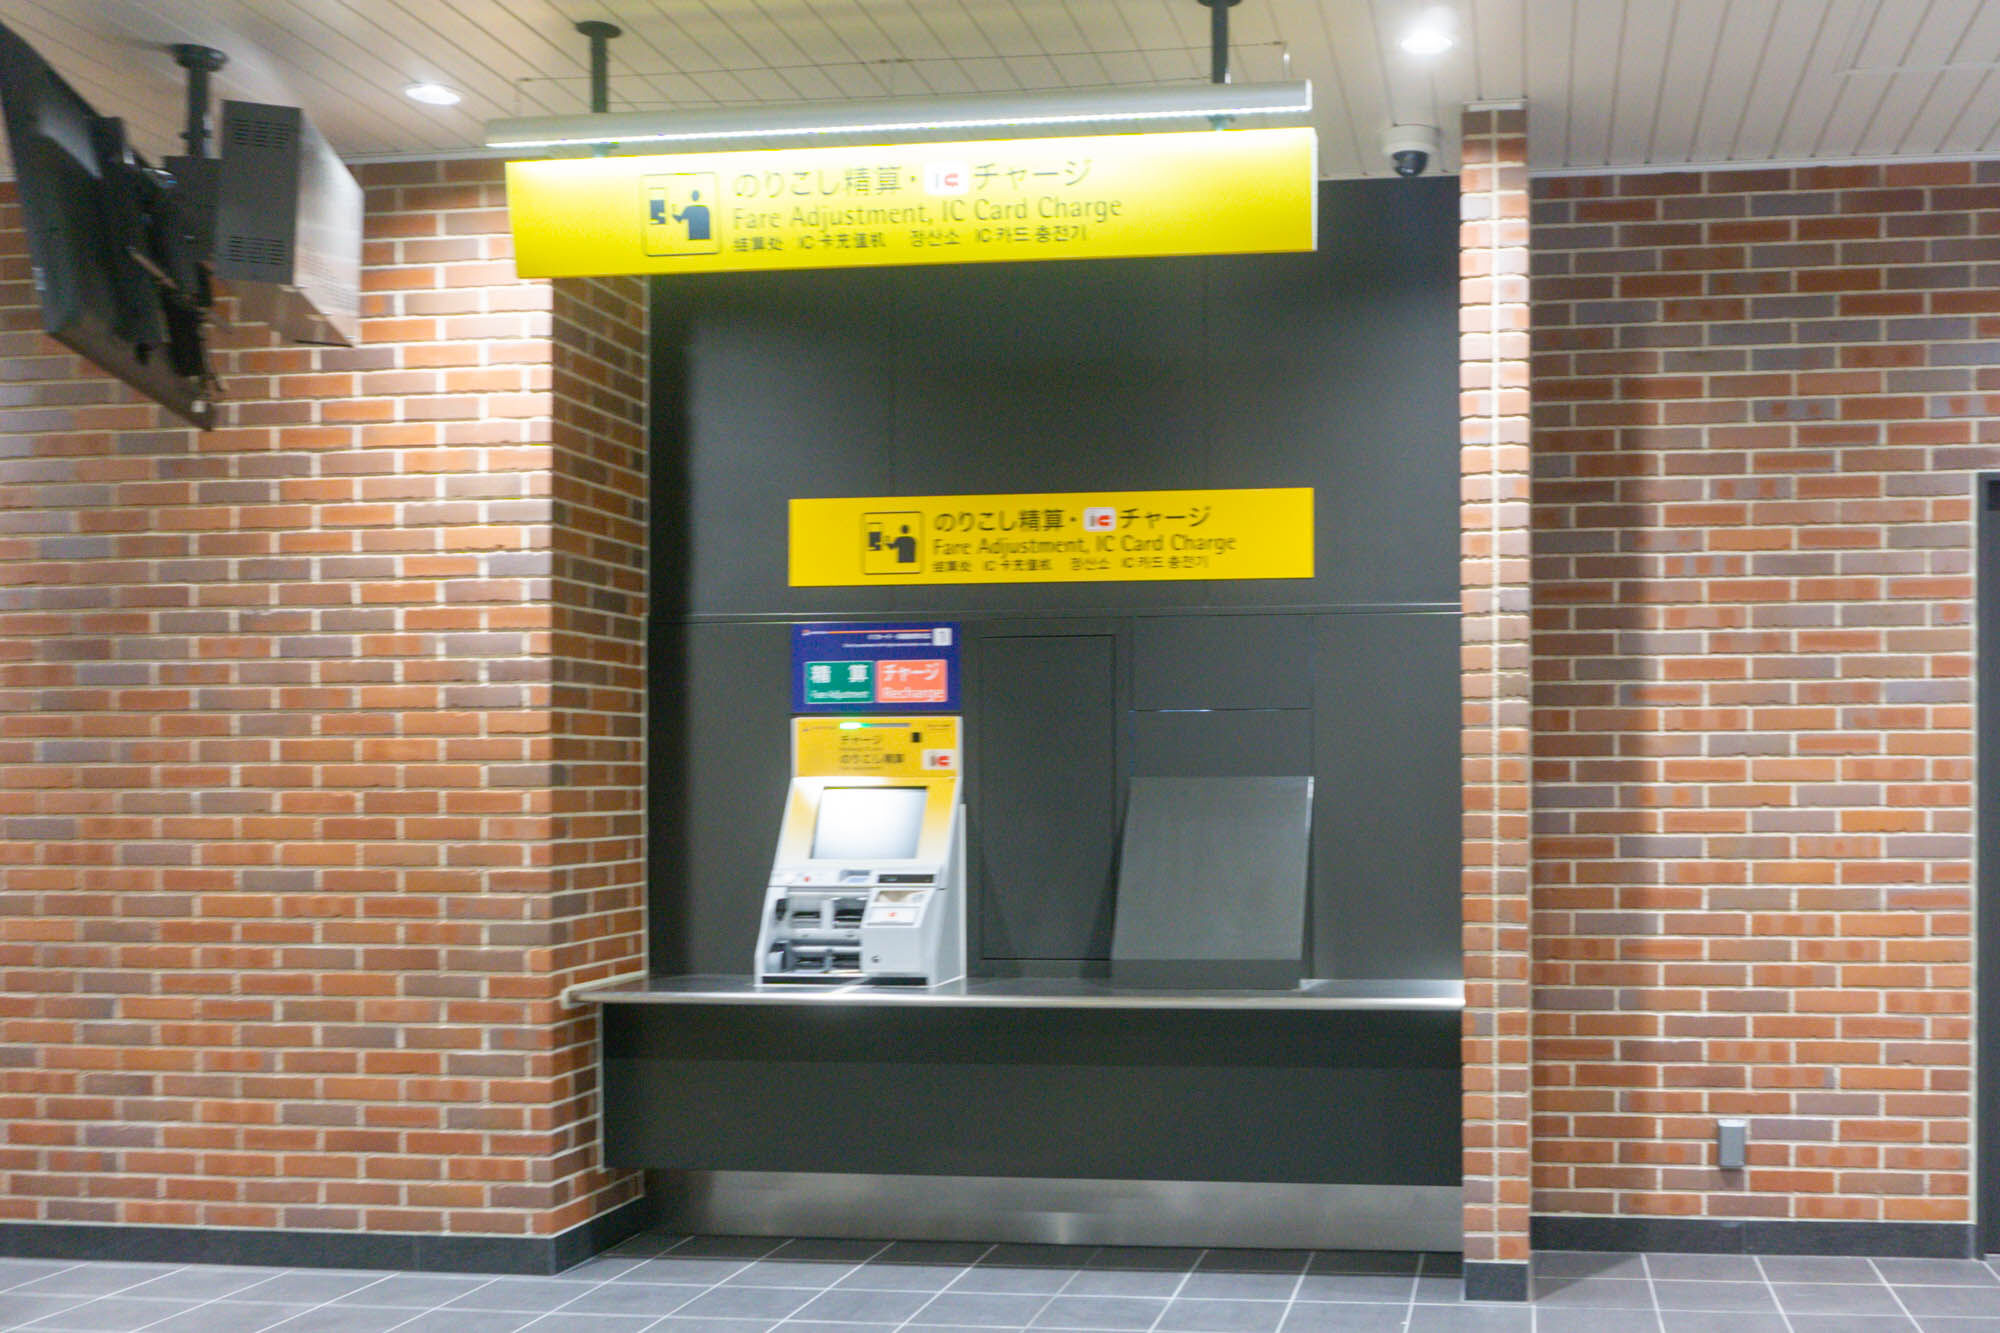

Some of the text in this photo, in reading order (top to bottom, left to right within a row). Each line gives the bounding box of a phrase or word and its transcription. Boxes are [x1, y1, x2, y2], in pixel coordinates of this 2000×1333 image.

[973, 158, 1092, 191] チャージ
[734, 195, 1123, 233] Fare Adjustment, IC Card Charge
[1120, 505, 1211, 529] チャージ
[933, 538, 972, 556] Fare
[1095, 535, 1116, 552] IC
[1120, 533, 1164, 552] Card
[1170, 532, 1237, 555] Charge
